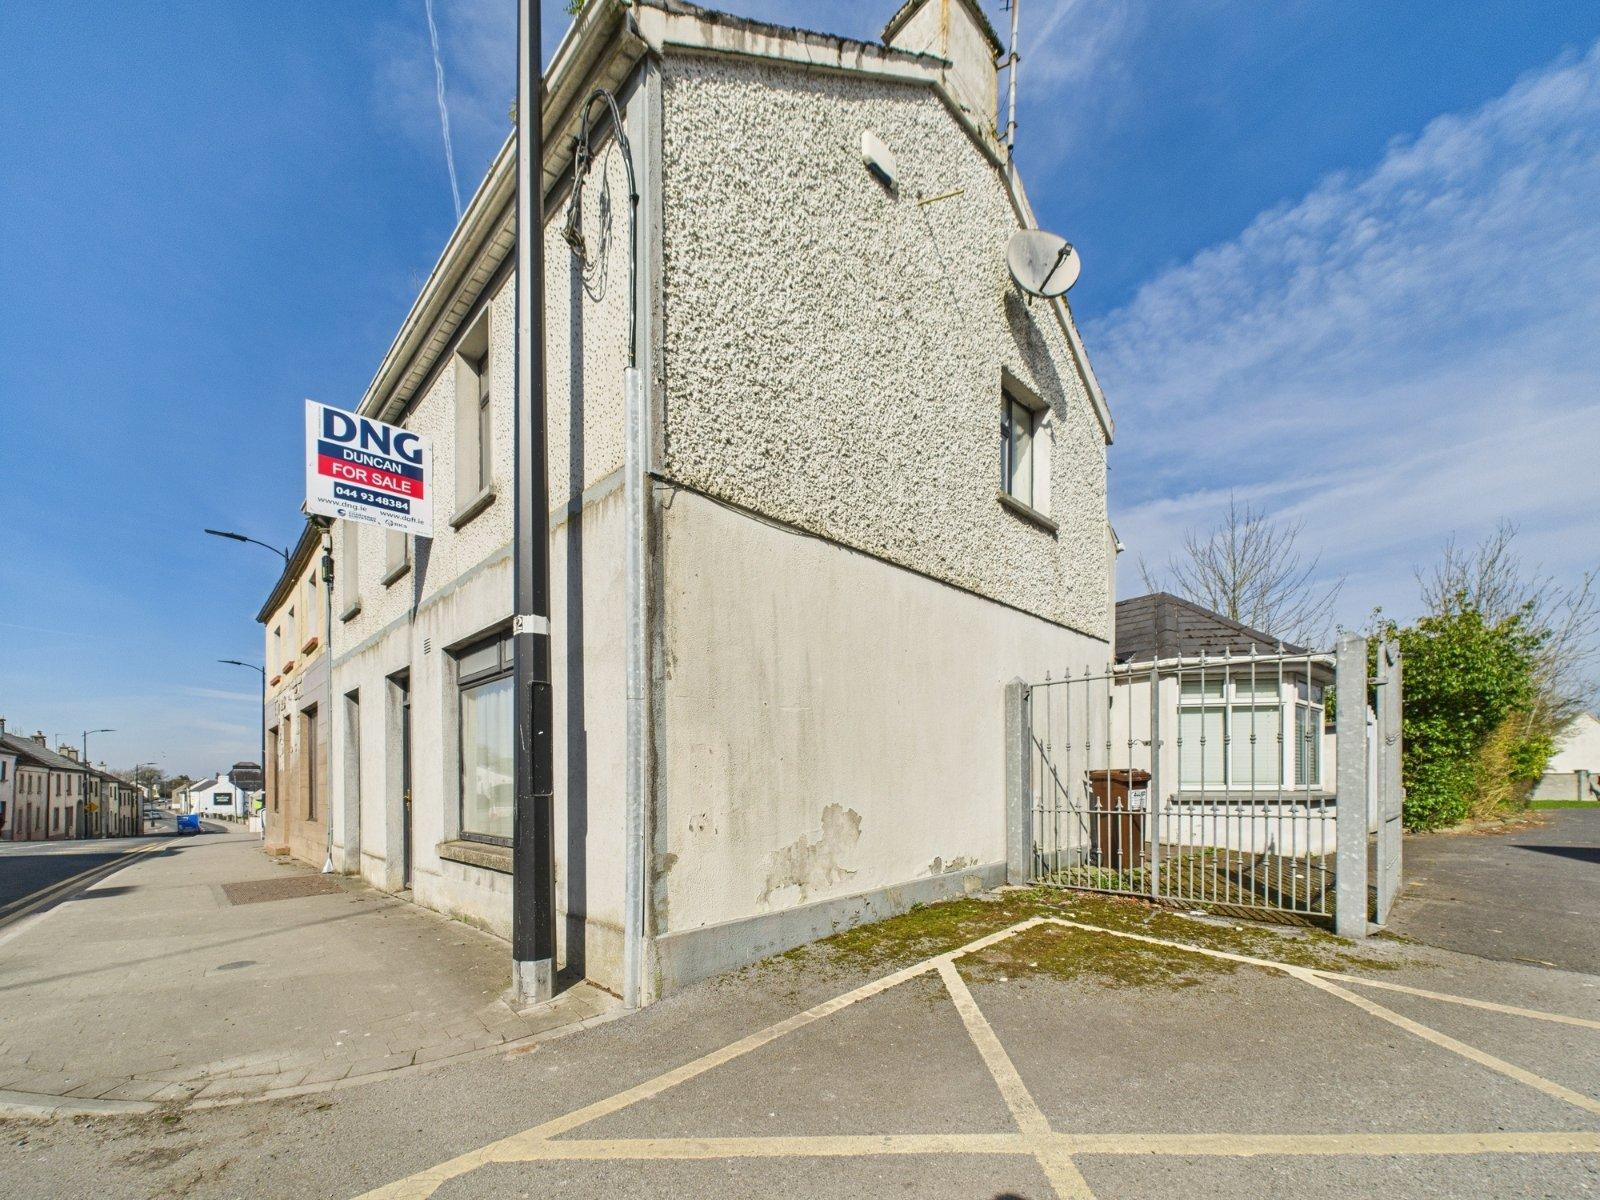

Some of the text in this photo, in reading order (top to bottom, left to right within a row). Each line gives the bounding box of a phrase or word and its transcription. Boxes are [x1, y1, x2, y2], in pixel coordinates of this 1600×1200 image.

[323, 406, 423, 465] DNG
[343, 449, 402, 474] DUNCAN
[332, 462, 412, 494] FOR SALE
[317, 496, 368, 512] www.dng.ie
[335, 486, 358, 498] 044
